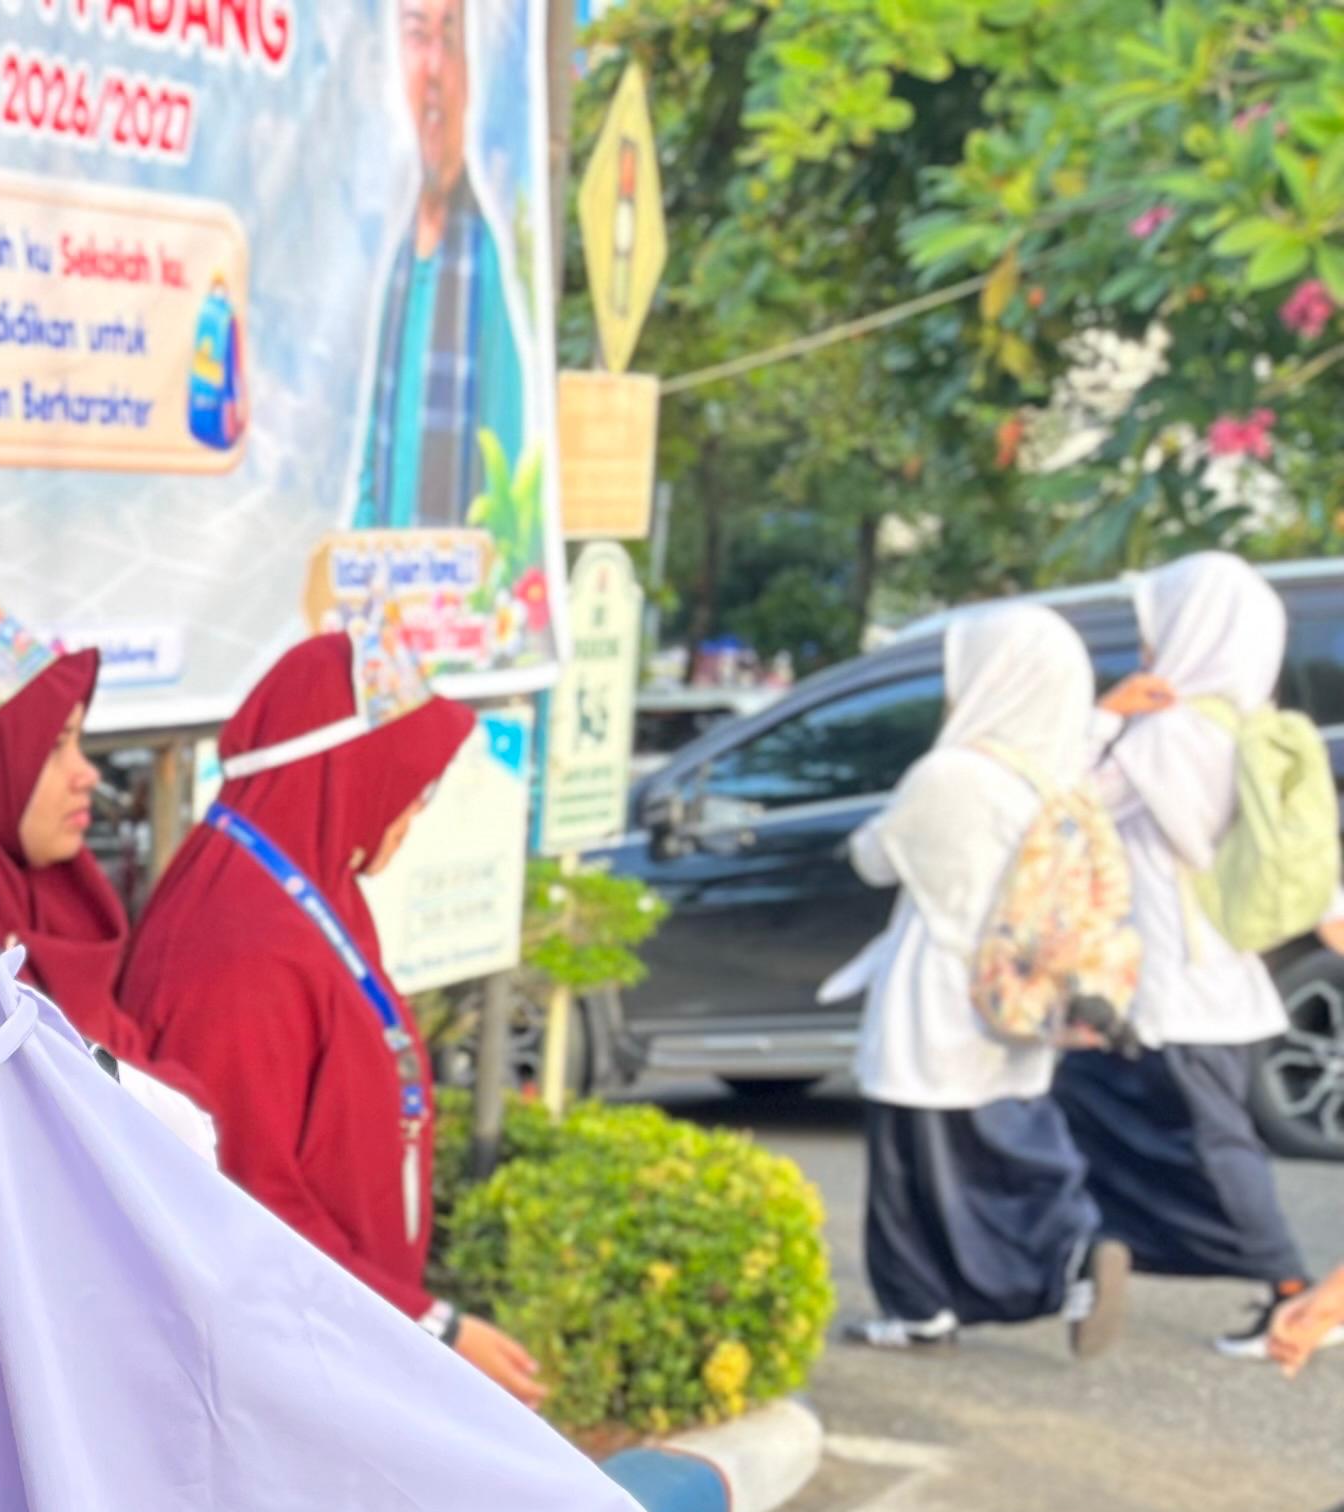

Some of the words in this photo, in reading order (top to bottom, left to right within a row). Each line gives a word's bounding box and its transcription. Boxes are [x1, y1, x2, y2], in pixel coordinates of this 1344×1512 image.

[3, 54, 190, 151] 2026/2027
[21, 226, 51, 273] ku
[61, 232, 152, 284] Sekolah
[88, 314, 146, 354] untuk
[22, 380, 152, 428] Berkarakter
